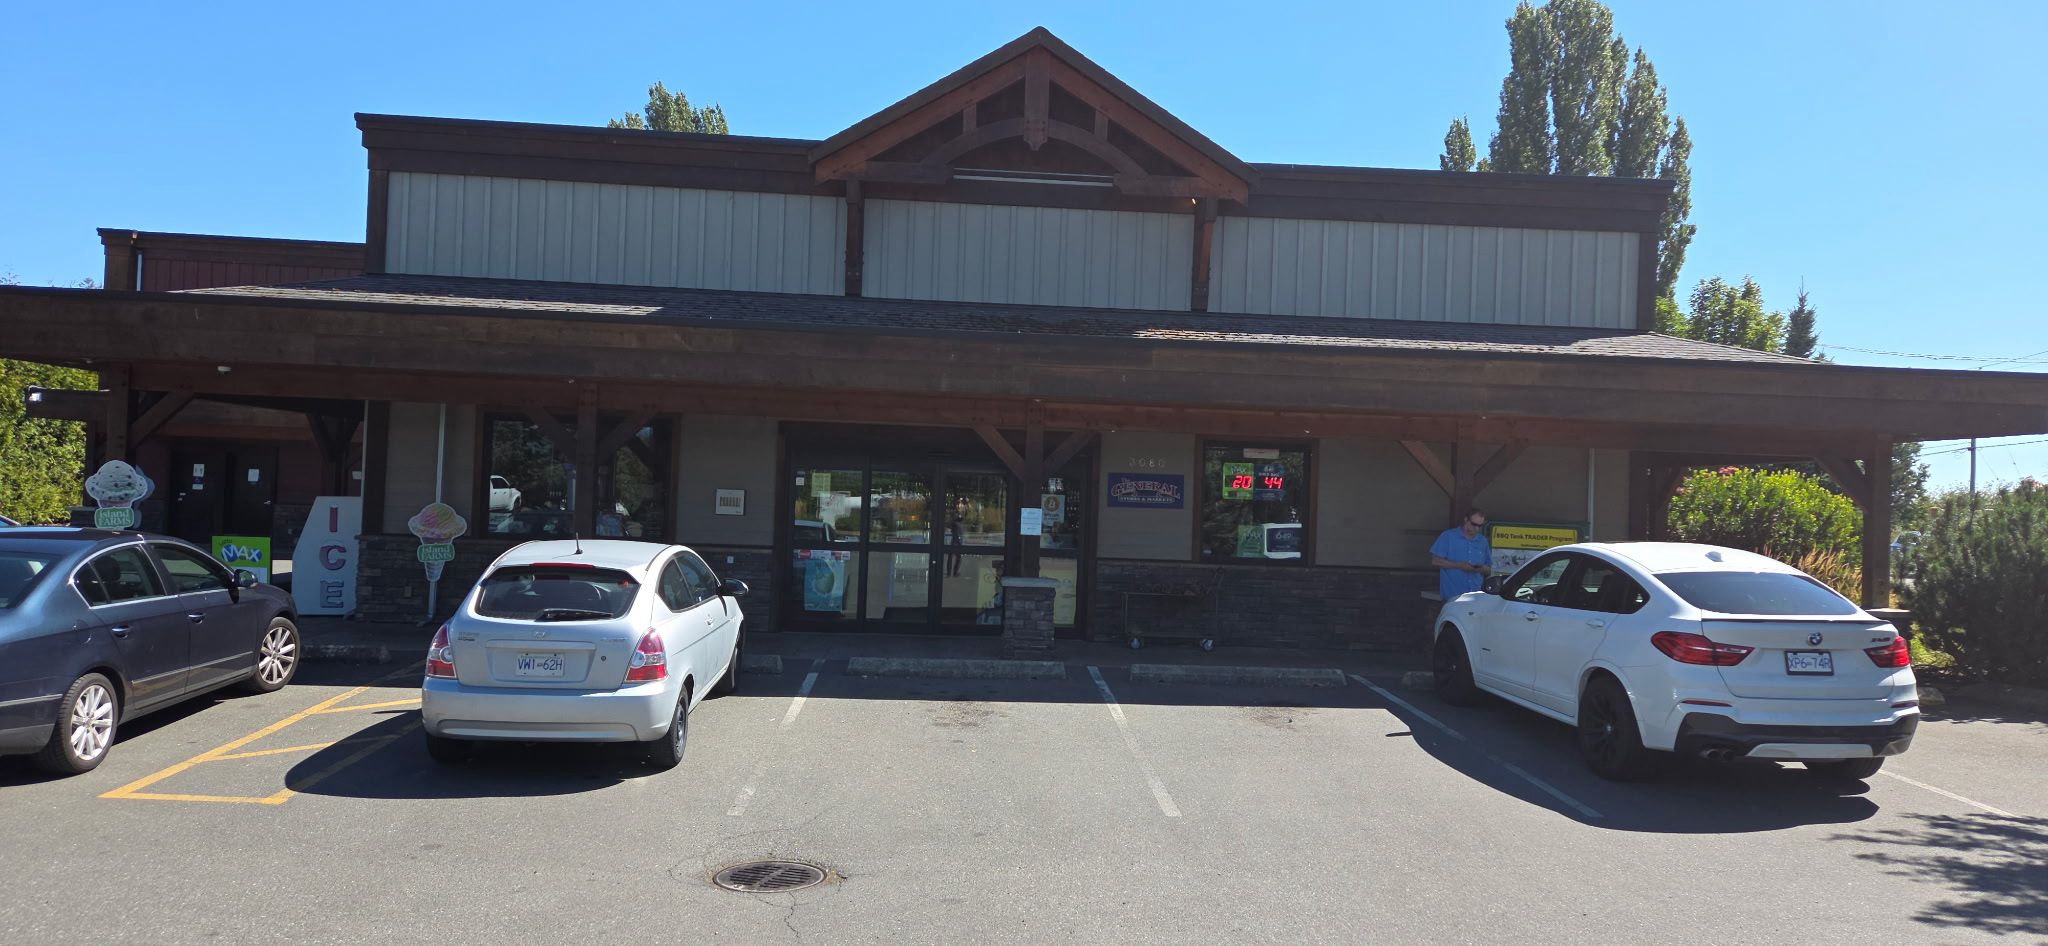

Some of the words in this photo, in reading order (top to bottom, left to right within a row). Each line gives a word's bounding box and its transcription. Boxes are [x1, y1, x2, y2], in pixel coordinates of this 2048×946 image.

[1232, 475, 1253, 489] 20
[1264, 477, 1283, 489] 44
[1111, 480, 1181, 500] GENERAL
[98, 517, 131, 526] FARMS
[222, 543, 262, 563] MAX
[319, 506, 347, 609] ICE
[421, 552, 452, 561] FARMS
